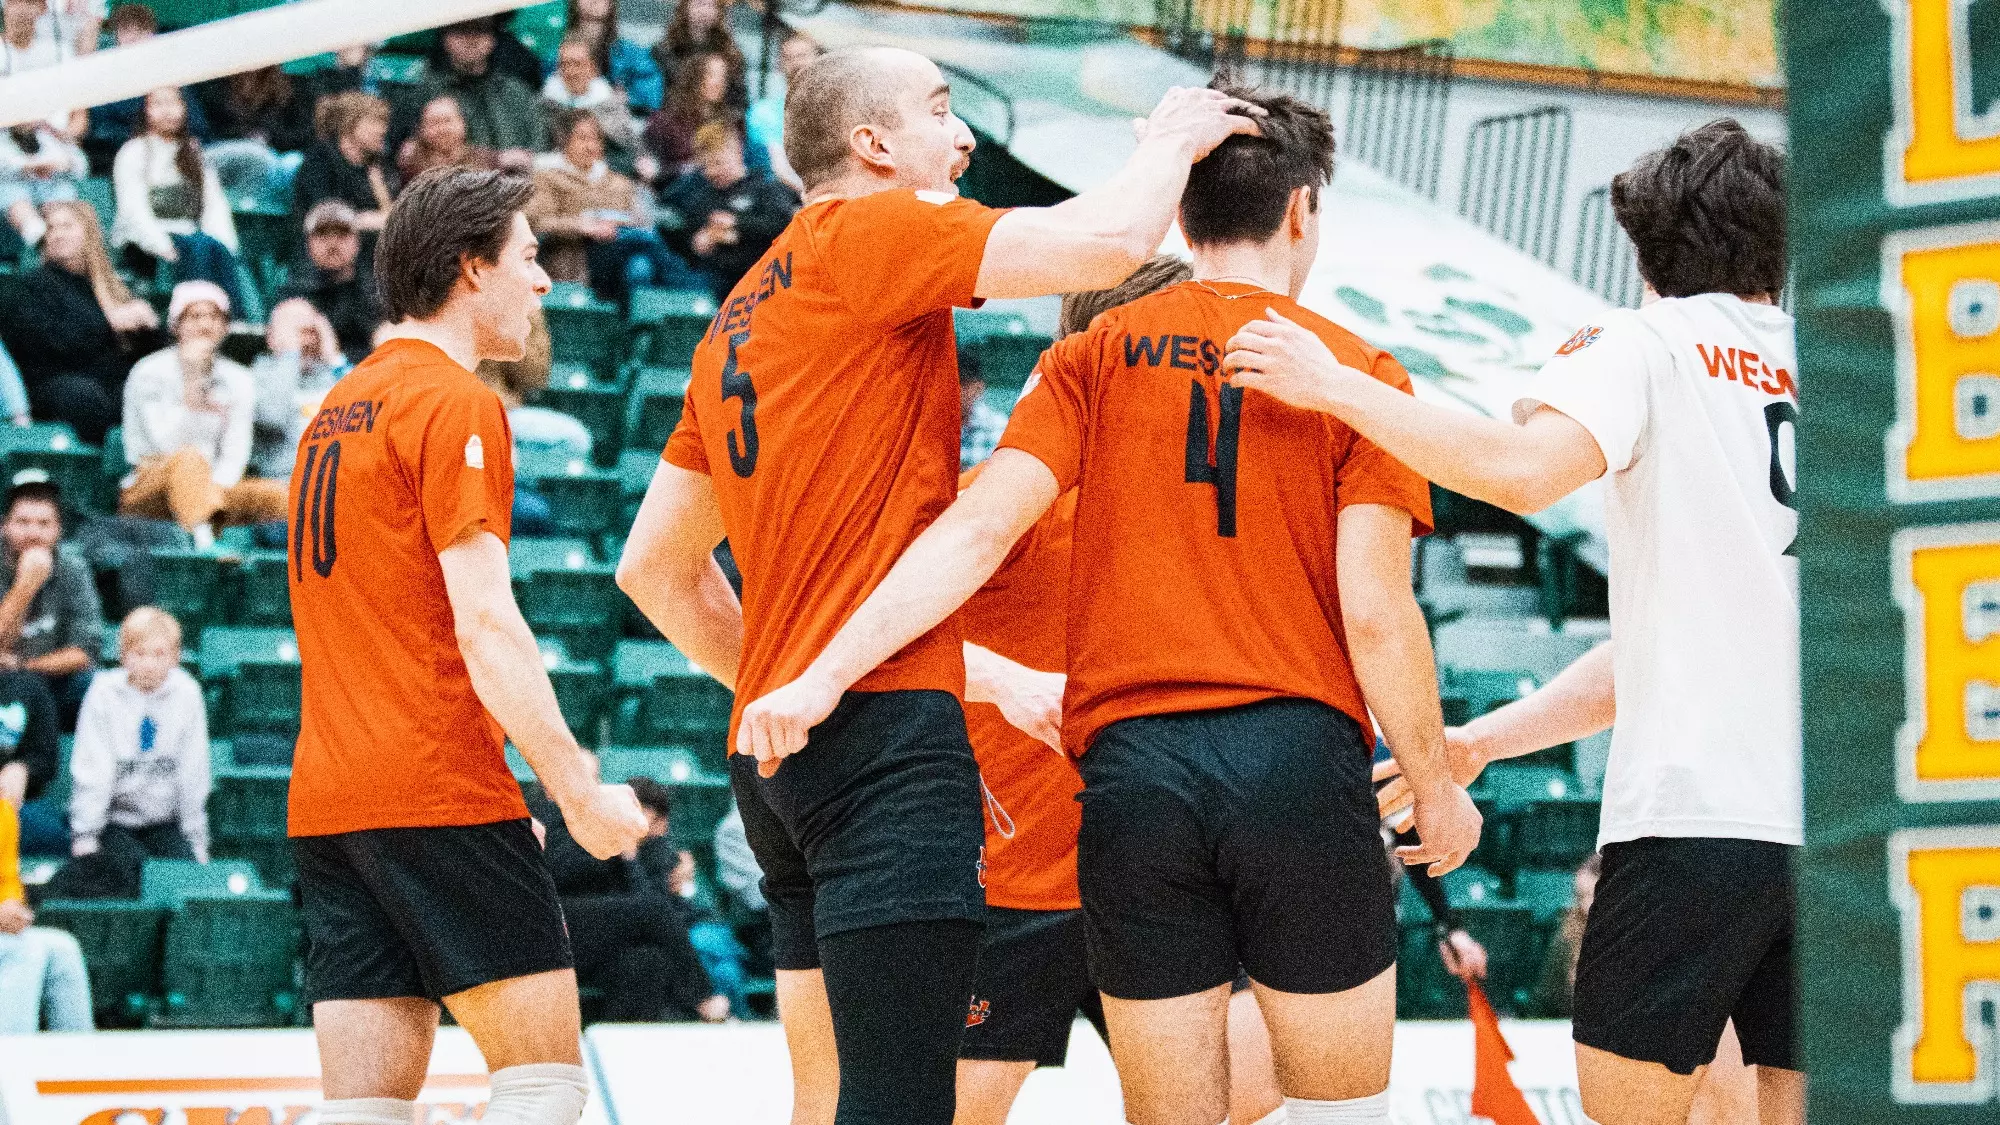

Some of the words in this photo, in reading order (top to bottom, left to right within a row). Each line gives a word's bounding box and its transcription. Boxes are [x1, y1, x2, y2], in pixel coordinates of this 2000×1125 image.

[720, 331, 759, 478] 5
[1184, 379, 1244, 538] 4
[293, 440, 342, 583] 10
